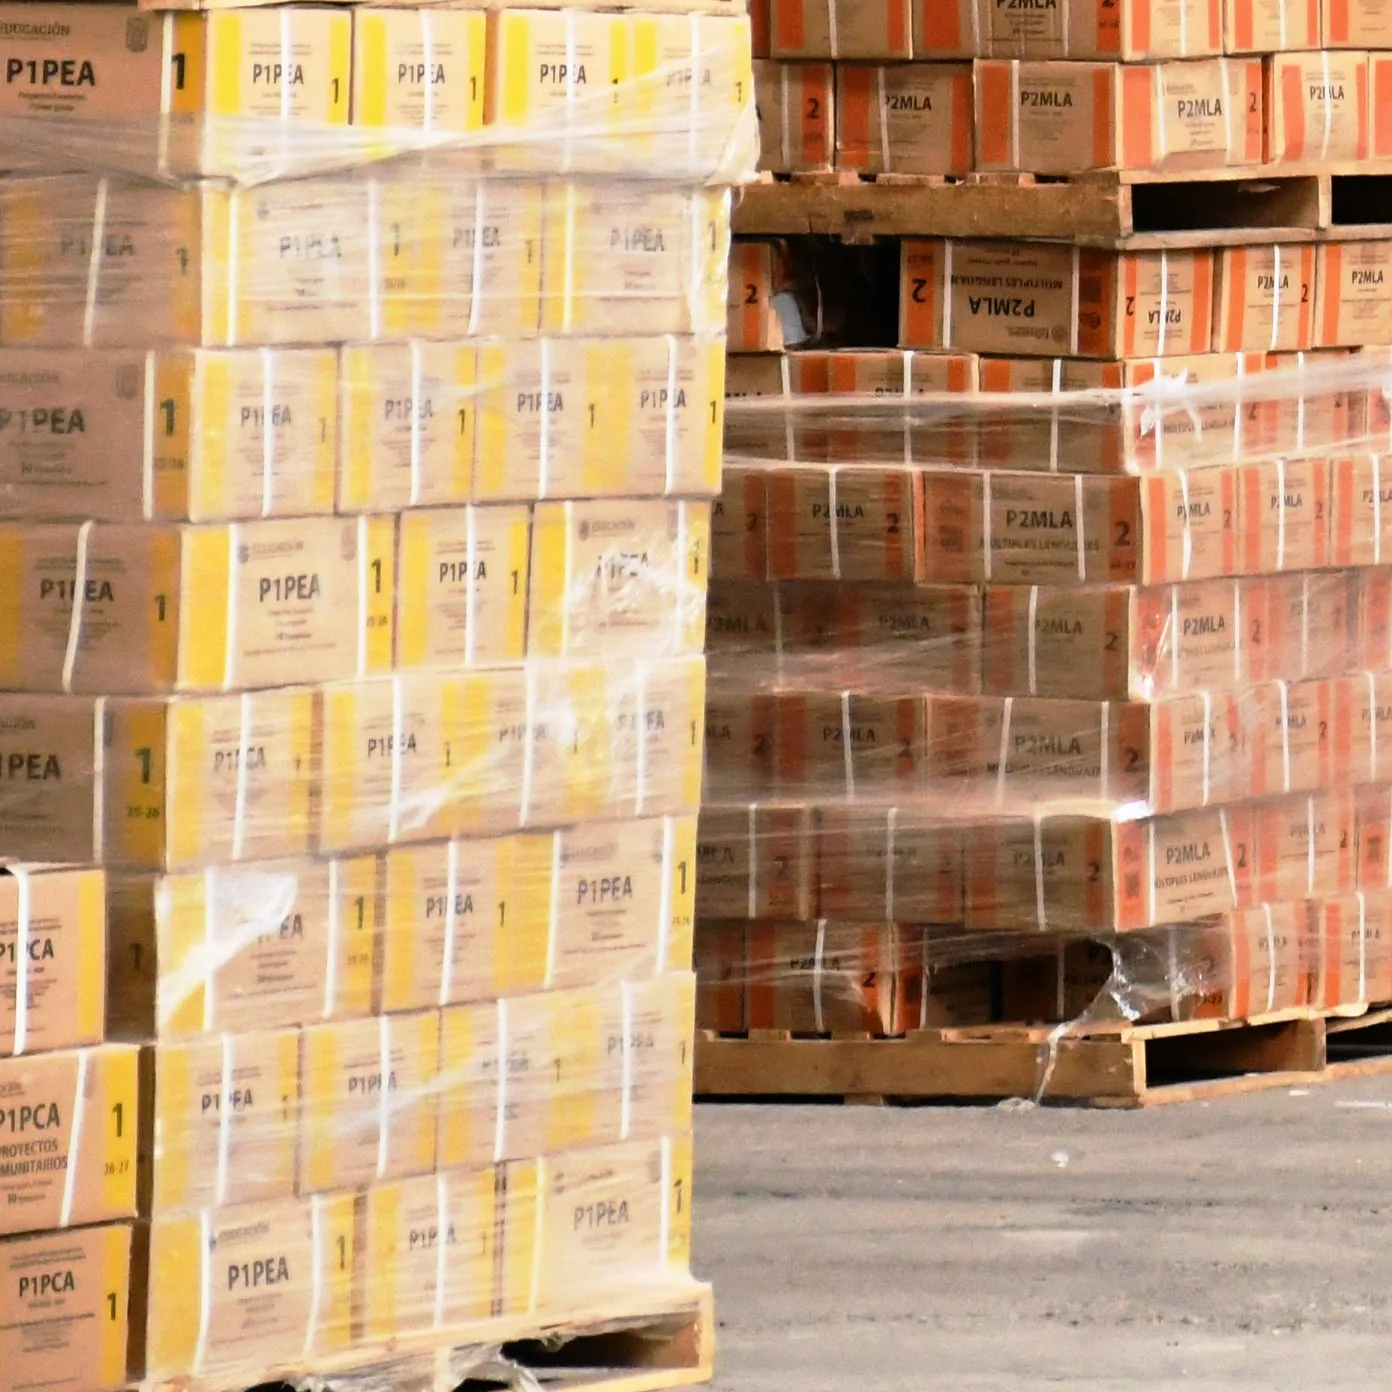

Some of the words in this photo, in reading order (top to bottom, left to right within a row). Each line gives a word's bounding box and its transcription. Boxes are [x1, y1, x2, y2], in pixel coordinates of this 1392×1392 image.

[7, 59, 96, 87] P1PEA
[171, 53, 185, 89] 1
[807, 98, 819, 119] 2
[1021, 91, 1072, 107] P2MLA
[1178, 99, 1222, 118] P2MLA
[1352, 271, 1383, 284] P2MLA
[1006, 510, 1072, 529] P2MLA
[1115, 522, 1130, 546] 2
[260, 574, 320, 602] P1PEA
[1183, 615, 1224, 635] P2MLA
[1014, 734, 1081, 755] P2MLA
[136, 747, 151, 784] 1
[1166, 841, 1211, 865] P2MLA
[578, 876, 632, 904] P1PEA
[113, 1103, 123, 1137] 1
[0, 1138, 58, 1158] ROYECTOS
[19, 1271, 75, 1298] P1PCA
[228, 1257, 288, 1289] P1PEA
[107, 1292, 117, 1320] 1
